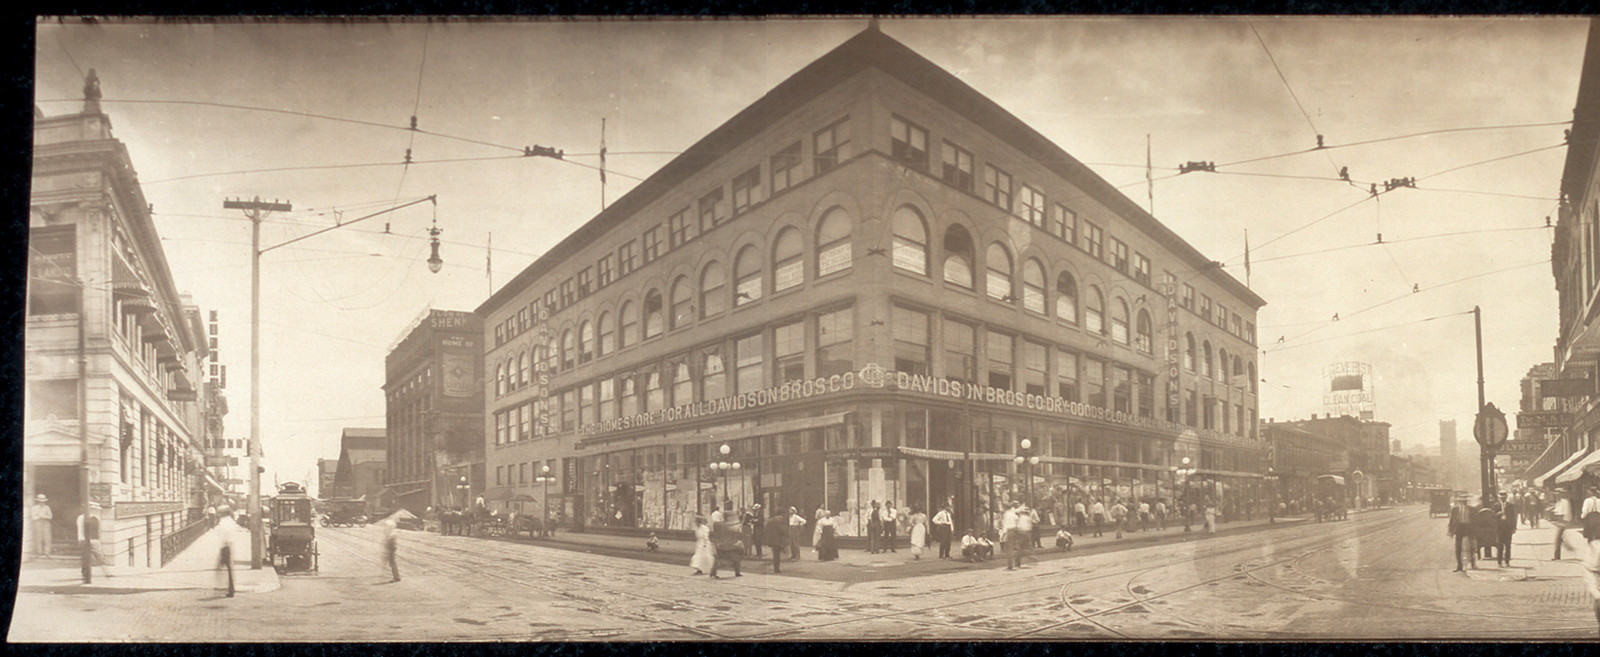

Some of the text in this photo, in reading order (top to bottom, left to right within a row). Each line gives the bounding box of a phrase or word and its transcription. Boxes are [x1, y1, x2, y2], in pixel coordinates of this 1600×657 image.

[579, 422, 597, 436] THE
[661, 405, 683, 423] FOR
[684, 401, 706, 418] ALL
[707, 387, 778, 415] DAVIDSON
[780, 377, 826, 401] BROS
[829, 371, 855, 391] CO
[986, 386, 1024, 407] BROS
[1351, 393, 1373, 404] COAL
